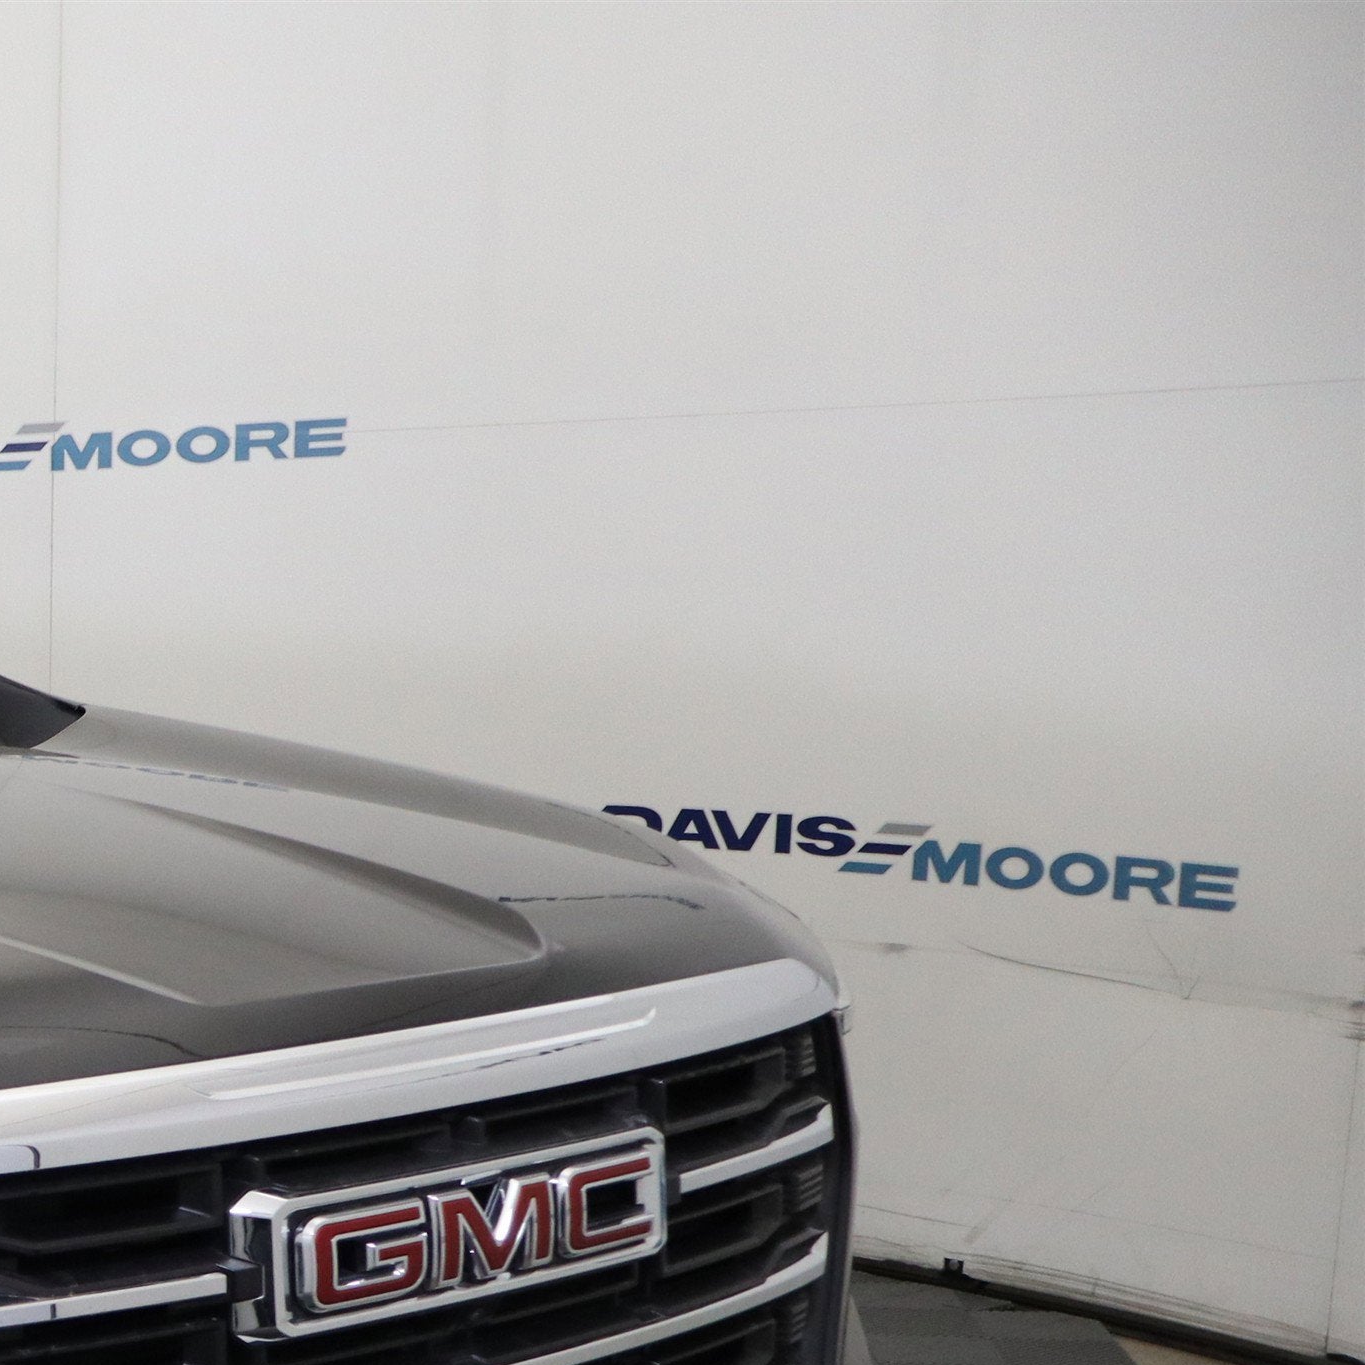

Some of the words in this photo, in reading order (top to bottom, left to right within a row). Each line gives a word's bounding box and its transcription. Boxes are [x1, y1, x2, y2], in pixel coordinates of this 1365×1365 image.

[50, 418, 347, 471] MOORE
[911, 839, 1239, 913] MOORE
[296, 1152, 655, 1312] GMC
